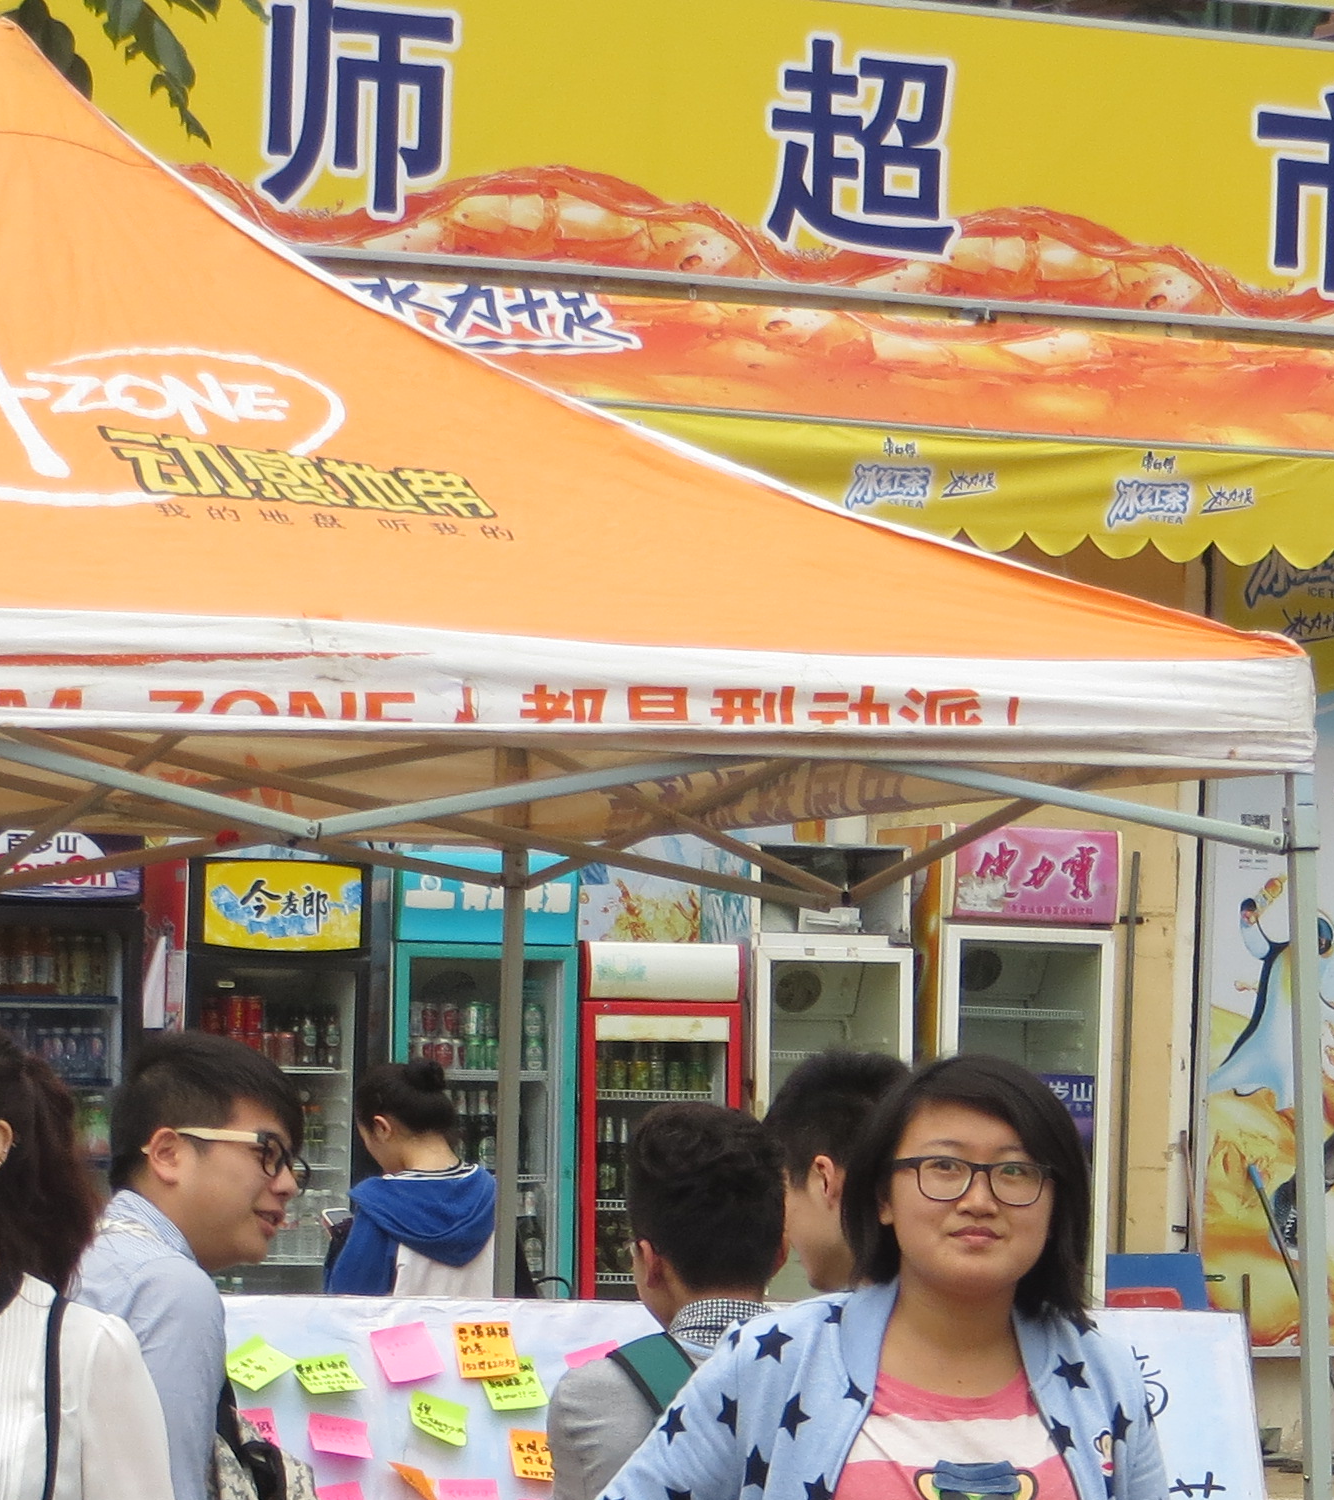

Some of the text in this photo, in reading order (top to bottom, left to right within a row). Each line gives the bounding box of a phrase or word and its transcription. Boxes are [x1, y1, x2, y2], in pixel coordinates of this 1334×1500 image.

[97, 426, 499, 518] 动感地带
[845, 465, 933, 511] 冰红茶
[1105, 480, 1192, 528] 冰红茶
[240, 879, 329, 934] 今麦郎
